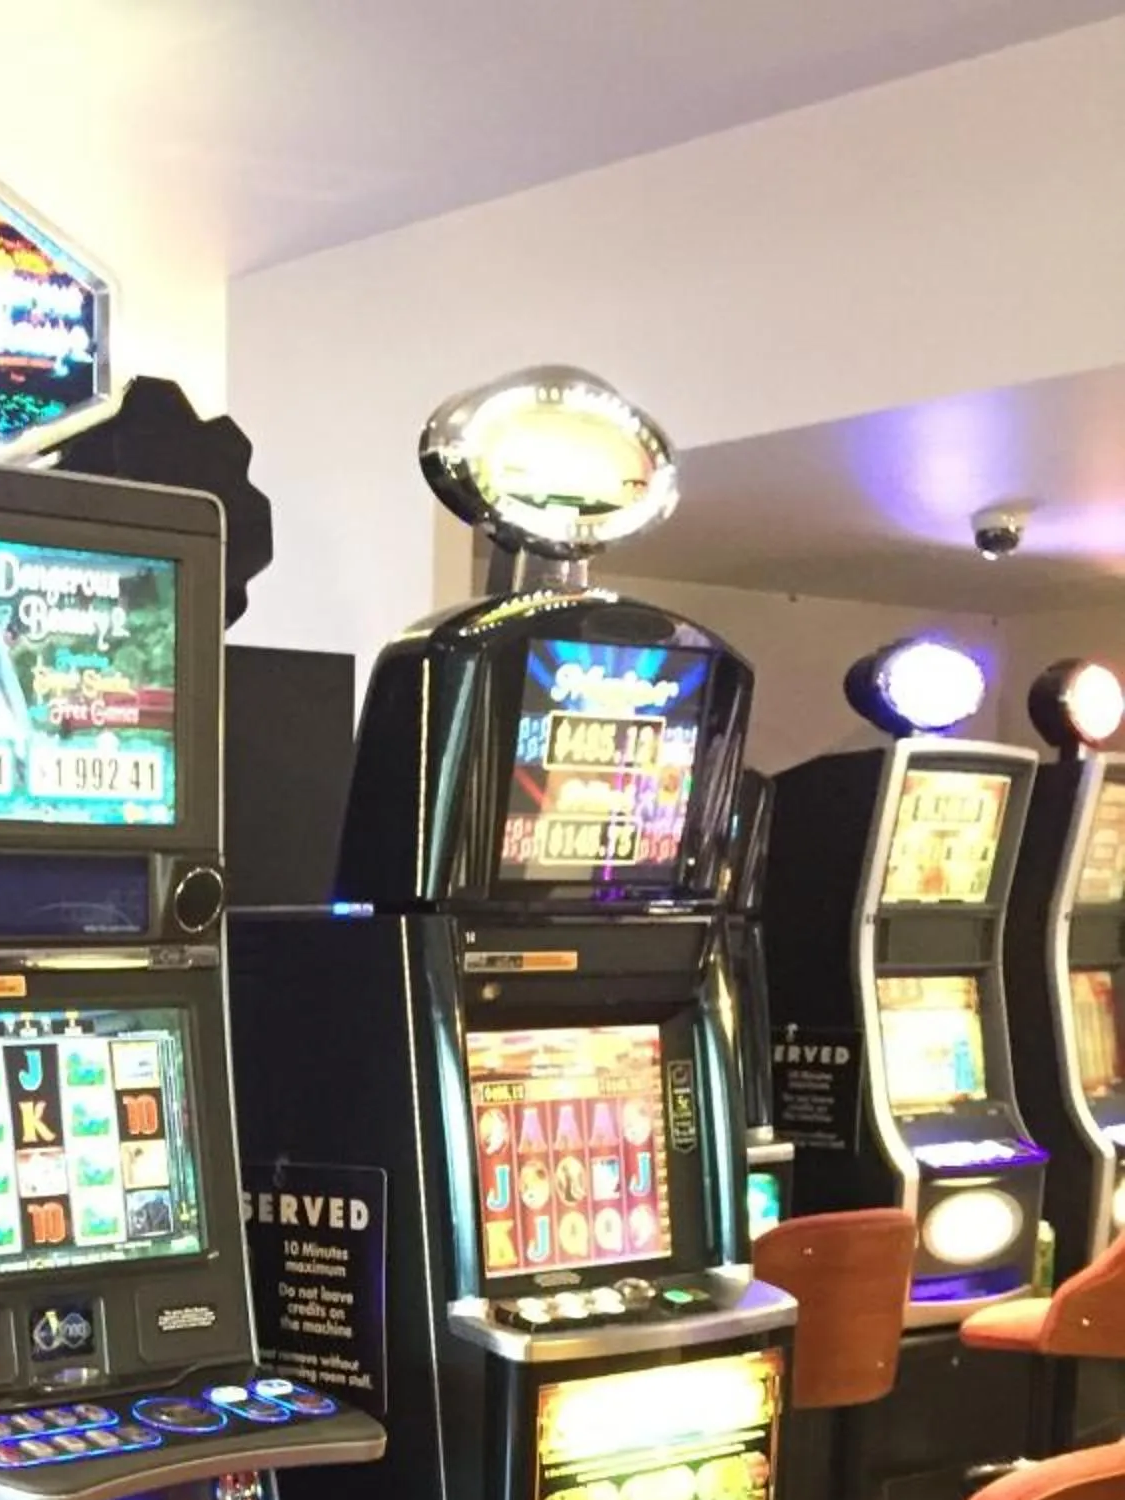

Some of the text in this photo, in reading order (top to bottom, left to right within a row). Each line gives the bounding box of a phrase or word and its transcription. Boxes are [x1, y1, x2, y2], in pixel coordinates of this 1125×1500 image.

[18, 1049, 42, 1090] J
[18, 1101, 56, 1143] K
[284, 1240, 348, 1261] 10 Minutes
[285, 1258, 346, 1277] maximum
[279, 1282, 353, 1305] Do not leave
[288, 1302, 345, 1319] credits on
[302, 1320, 352, 1338] machine
